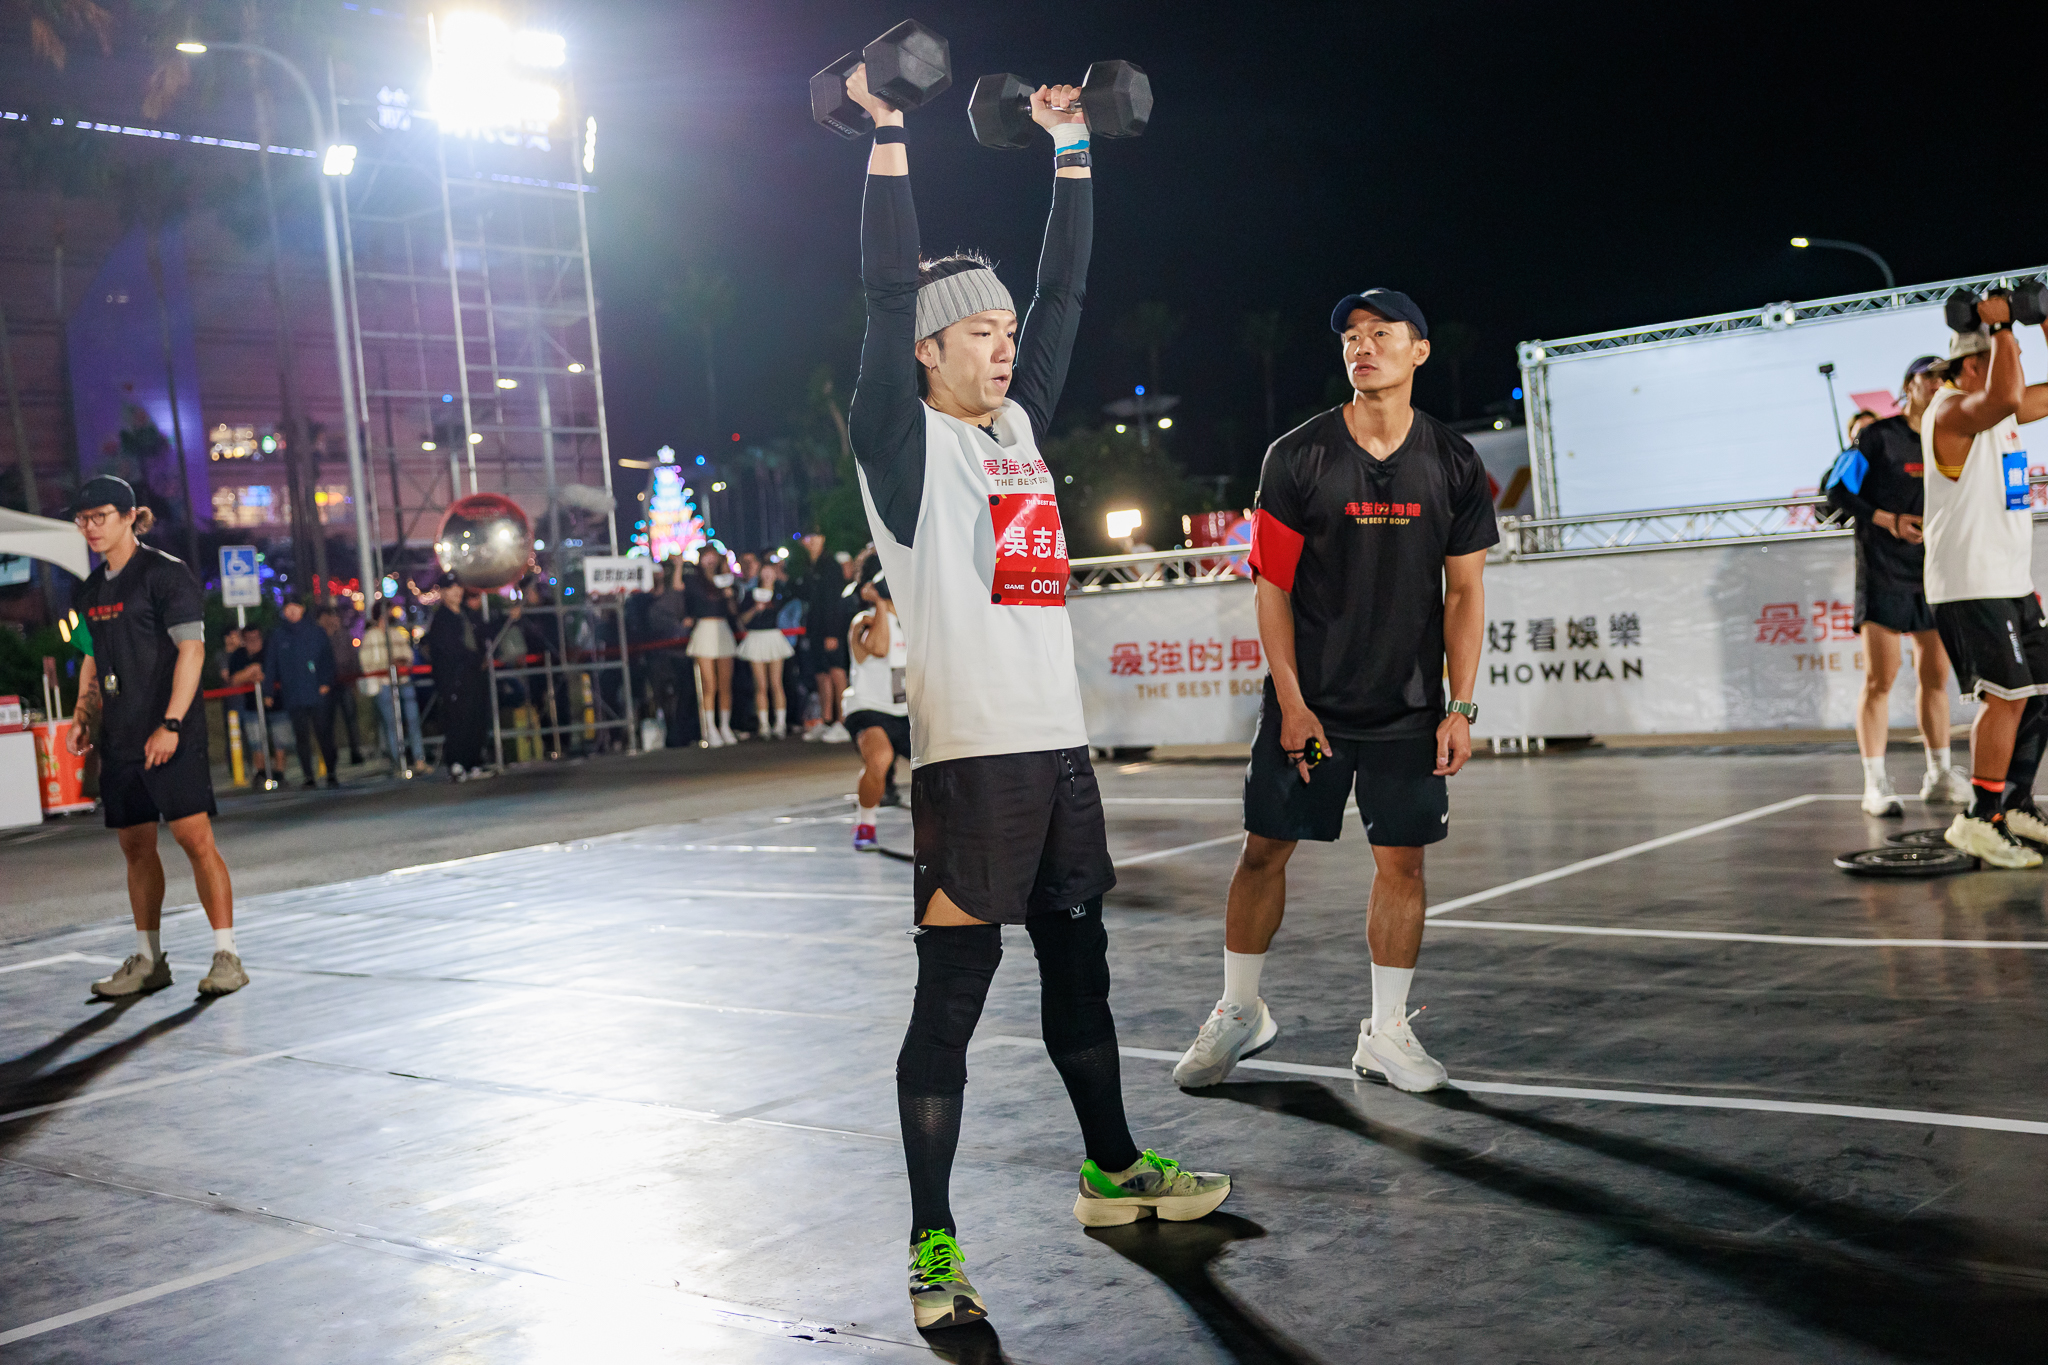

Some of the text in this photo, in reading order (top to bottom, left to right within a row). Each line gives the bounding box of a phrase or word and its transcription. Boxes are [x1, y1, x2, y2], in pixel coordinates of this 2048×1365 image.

[994, 478, 1014, 487] THE
[1017, 476, 1038, 487] BEST
[1355, 516, 1411, 526] THE BEST BODY
[1030, 579, 1060, 595] 0011
[1487, 611, 1642, 653] 好看娛樂
[1488, 656, 1643, 685] HOWKAN
[1792, 653, 1842, 672] THE
[1135, 683, 1168, 699] THE
[1176, 680, 1221, 697] BEST
